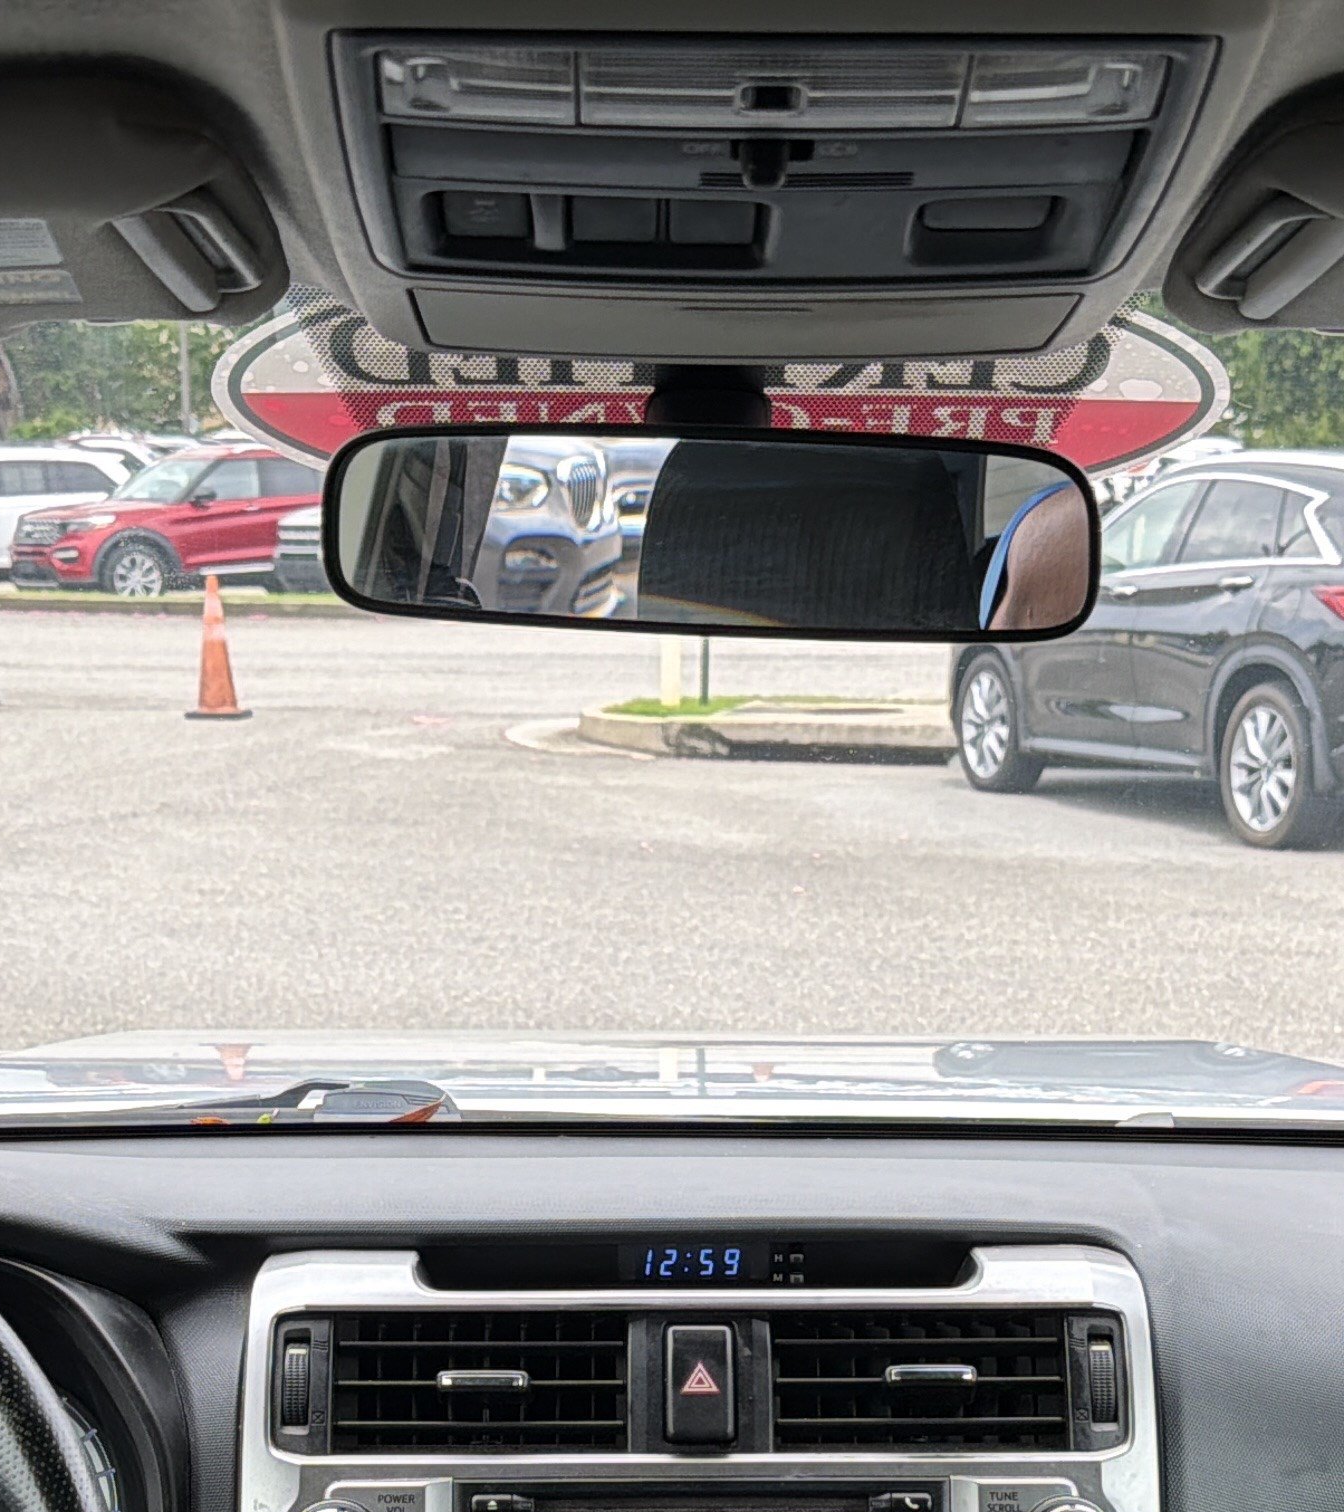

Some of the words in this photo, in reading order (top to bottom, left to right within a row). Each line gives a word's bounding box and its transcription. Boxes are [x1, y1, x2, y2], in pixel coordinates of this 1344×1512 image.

[644, 1248, 742, 1277] 12:59
[377, 1494, 416, 1505] POWER
[989, 1491, 1018, 1501] TUNE
